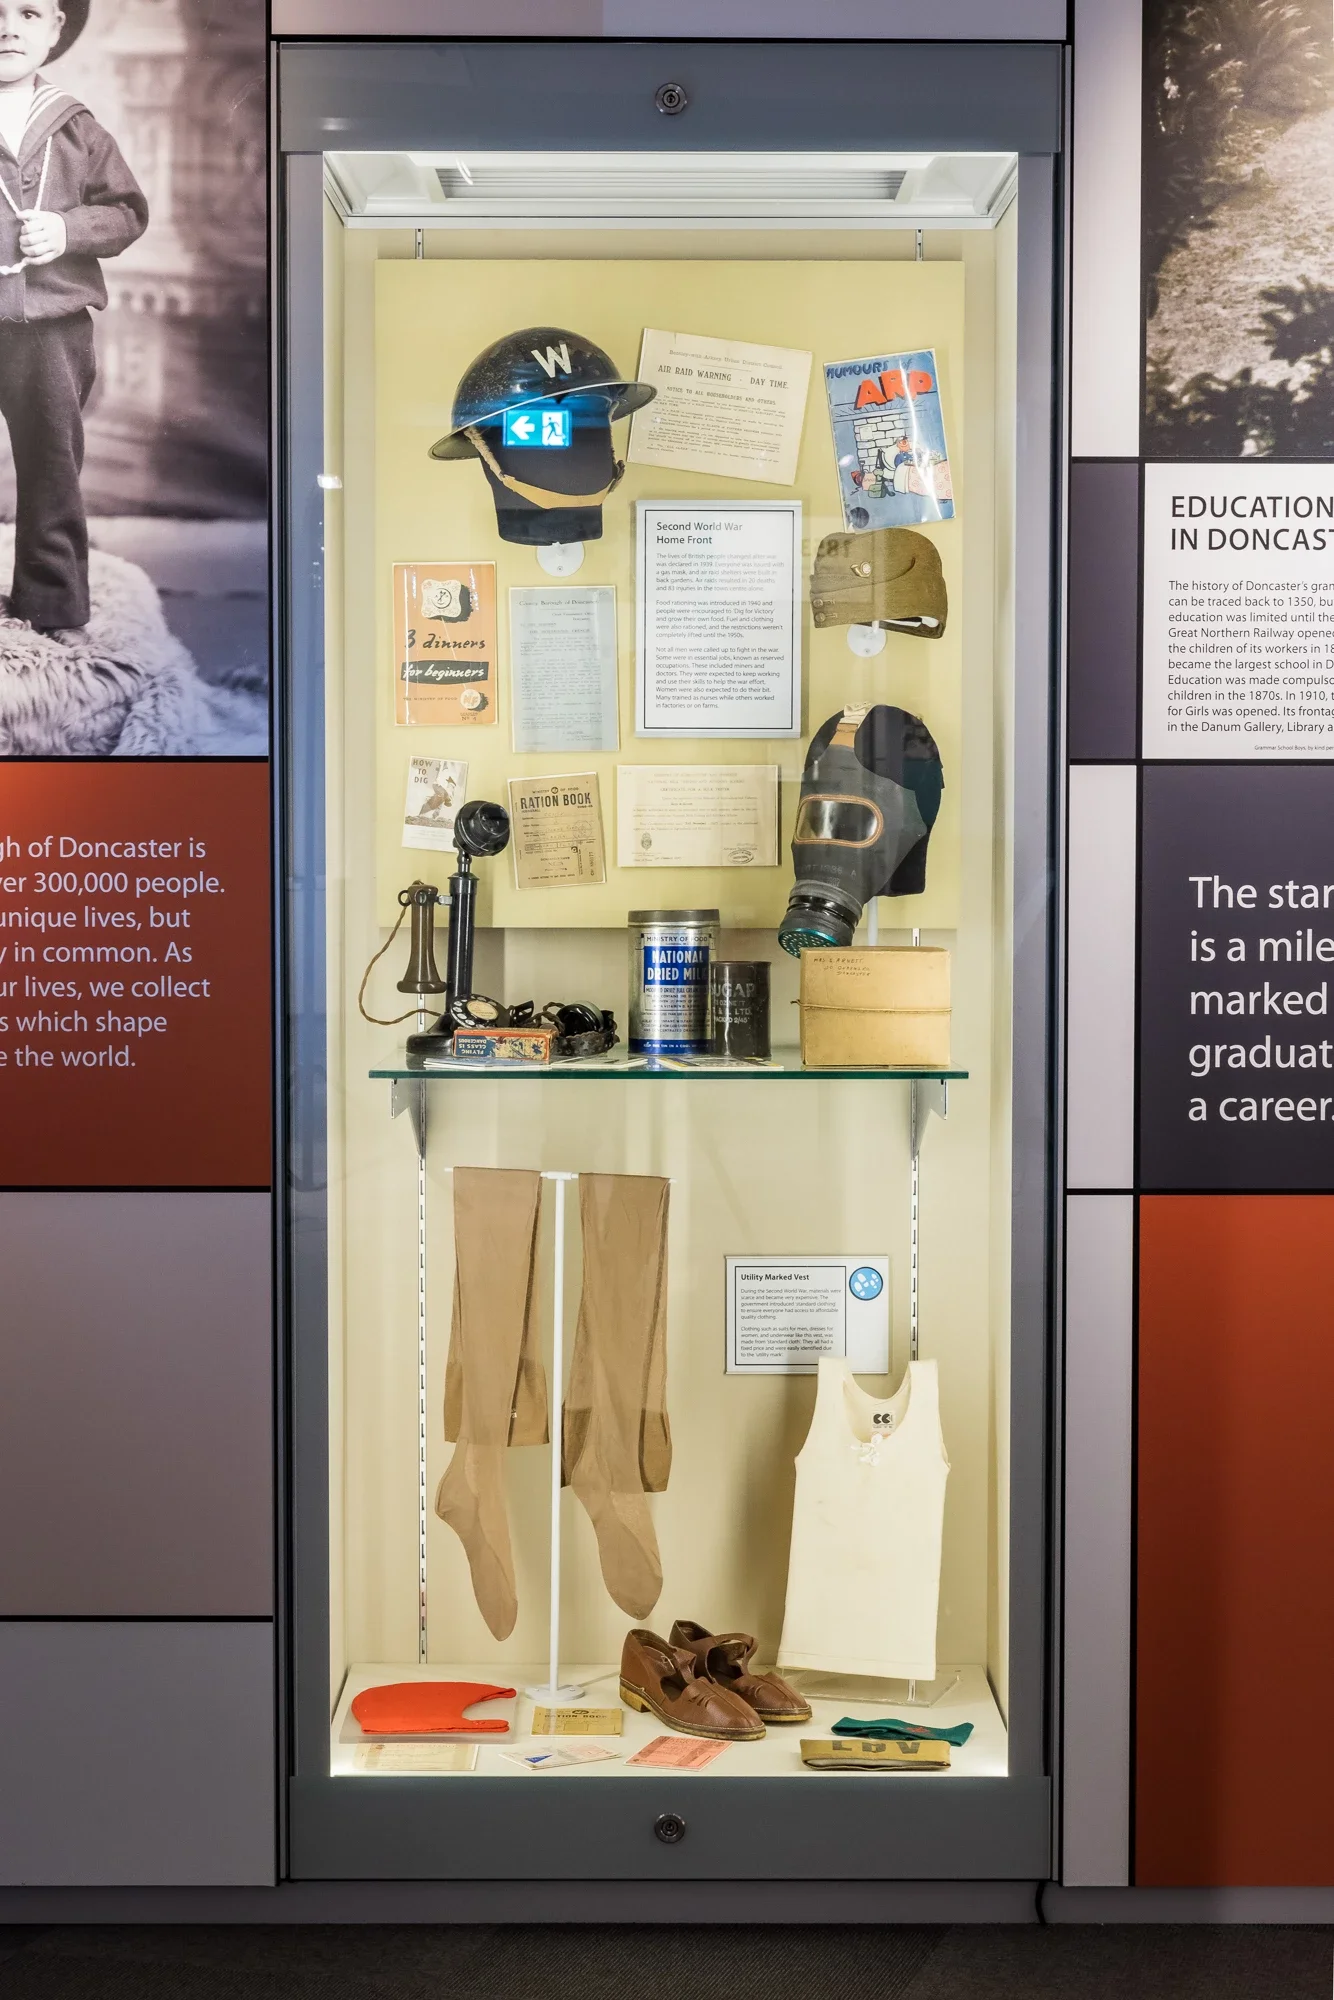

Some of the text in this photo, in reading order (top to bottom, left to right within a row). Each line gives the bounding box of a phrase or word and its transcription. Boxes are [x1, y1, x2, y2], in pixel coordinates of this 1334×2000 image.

[530, 342, 573, 378] W
[658, 364, 672, 374] AIR
[675, 366, 693, 376] RAID
[697, 371, 732, 382] WARNING
[750, 377, 766, 386] DAY
[854, 369, 933, 411] ARP
[1172, 496, 1334, 518] EDUCATION
[656, 521, 743, 532] Second World War
[656, 535, 713, 545] Home Front
[1171, 528, 1334, 551] IN DONCAS
[1168, 580, 1334, 594] The history of Doncaster's gran
[1168, 596, 1333, 607] can be traced back to 1350, bu
[1168, 612, 1334, 622] education was limited until the
[405, 629, 486, 650] 3 dinners
[1168, 627, 1198, 638] Great
[1201, 628, 1250, 638] Northern
[1253, 627, 1295, 640] Railway
[1168, 643, 1186, 654] the
[1188, 643, 1233, 654] children
[1236, 642, 1248, 654] of
[1249, 643, 1262, 654] its
[1264, 643, 1308, 654] workers
[1310, 643, 1321, 654] in
[402, 663, 485, 681] for beginners
[1168, 658, 1212, 669] became
[1214, 659, 1232, 670] the
[1235, 658, 1272, 672] largest
[1274, 659, 1310, 670] school
[1312, 660, 1322, 669] in
[1168, 674, 1222, 685] Education
[1225, 677, 1246, 685] was
[1249, 674, 1280, 685] made
[656, 694, 671, 702] Many
[1167, 690, 1212, 701] children
[1215, 690, 1225, 700] in
[1228, 690, 1246, 701] the
[1250, 690, 1283, 701] 1870s.
[1286, 691, 1296, 700] In
[1300, 690, 1328, 701] 1910,
[1167, 705, 1183, 716] for
[1185, 706, 1209, 716] Girls
[1212, 708, 1233, 716] was
[1235, 706, 1280, 718] opened.
[1283, 706, 1296, 716] Its
[1168, 721, 1333, 734] in the Danum Gallery, Library a
[413, 759, 433, 767] HOW
[414, 776, 428, 784] DIG
[520, 792, 591, 809] RATION BOOK
[28, 835, 54, 858] of
[60, 836, 182, 858] Doncaster
[189, 837, 206, 858] is
[0, 871, 225, 898] er 300,000 people.
[1188, 875, 1334, 909] The star
[84, 906, 142, 931] lives,
[150, 906, 191, 928] but
[14, 941, 35, 962] in
[42, 946, 157, 962] common.
[164, 942, 192, 962] As
[1191, 928, 1334, 962] is a mile
[652, 950, 704, 964] NATIONAL
[647, 967, 679, 981] DRIED
[25, 975, 82, 1000] lives,
[89, 982, 124, 997] we
[131, 975, 210, 998] collect
[1190, 982, 1327, 1015] marked
[16, 1010, 88, 1032] which
[96, 1010, 167, 1038] shape
[14, 1044, 54, 1067] the
[60, 1044, 136, 1067] world.
[1189, 1034, 1333, 1077] graduat
[1188, 1098, 1207, 1121] a
[740, 1273, 764, 1283] Utility
